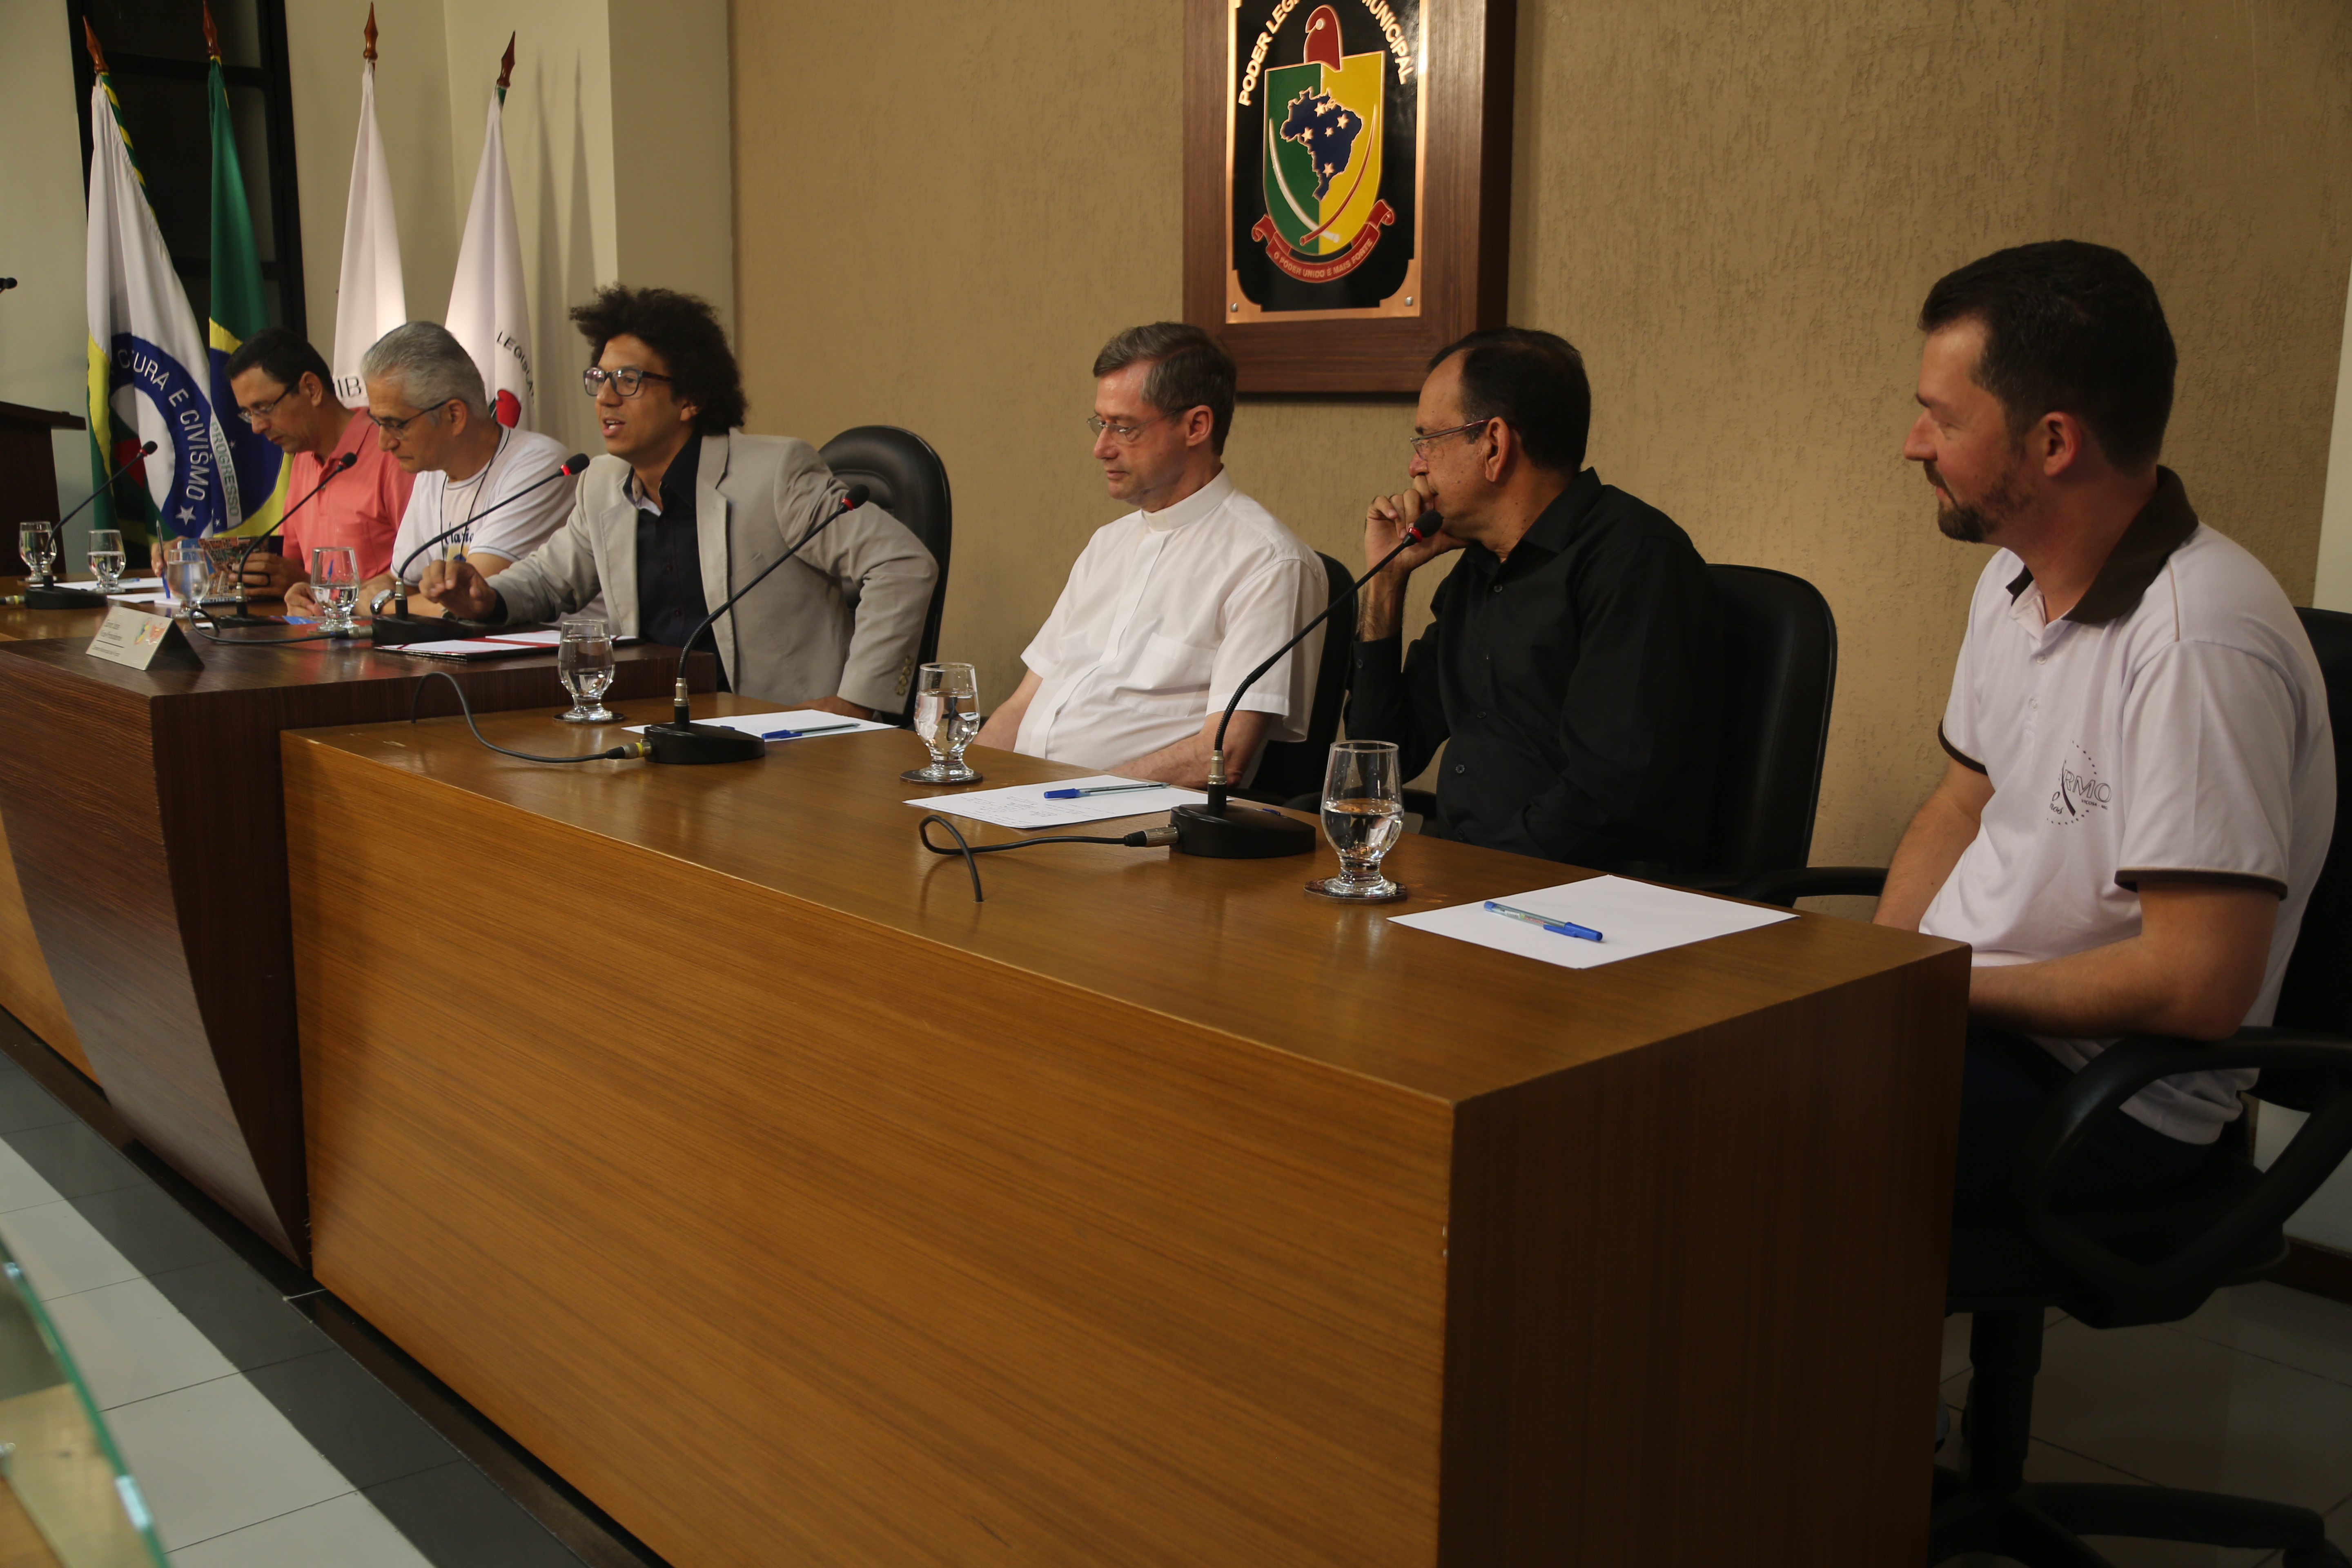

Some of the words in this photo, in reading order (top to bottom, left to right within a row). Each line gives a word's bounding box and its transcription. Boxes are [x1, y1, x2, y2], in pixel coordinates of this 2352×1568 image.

[1238, 31, 1273, 106] PODER
[1265, 0, 1301, 34] LEG
[1273, 250, 1279, 260] O
[1279, 256, 1301, 275] PODER
[1302, 269, 1325, 278] UNIDO
[1327, 266, 1333, 276] É
[1333, 260, 1351, 275] MAIS
[1351, 237, 1372, 264] FORTE
[337, 376, 361, 398] IB
[168, 388, 189, 408] E
[180, 410, 210, 501] CIVISMO
[210, 421, 239, 517] PROGRESSO
[2062, 769, 2111, 803] RMO
[2081, 799, 2097, 807] VIÇOSA
